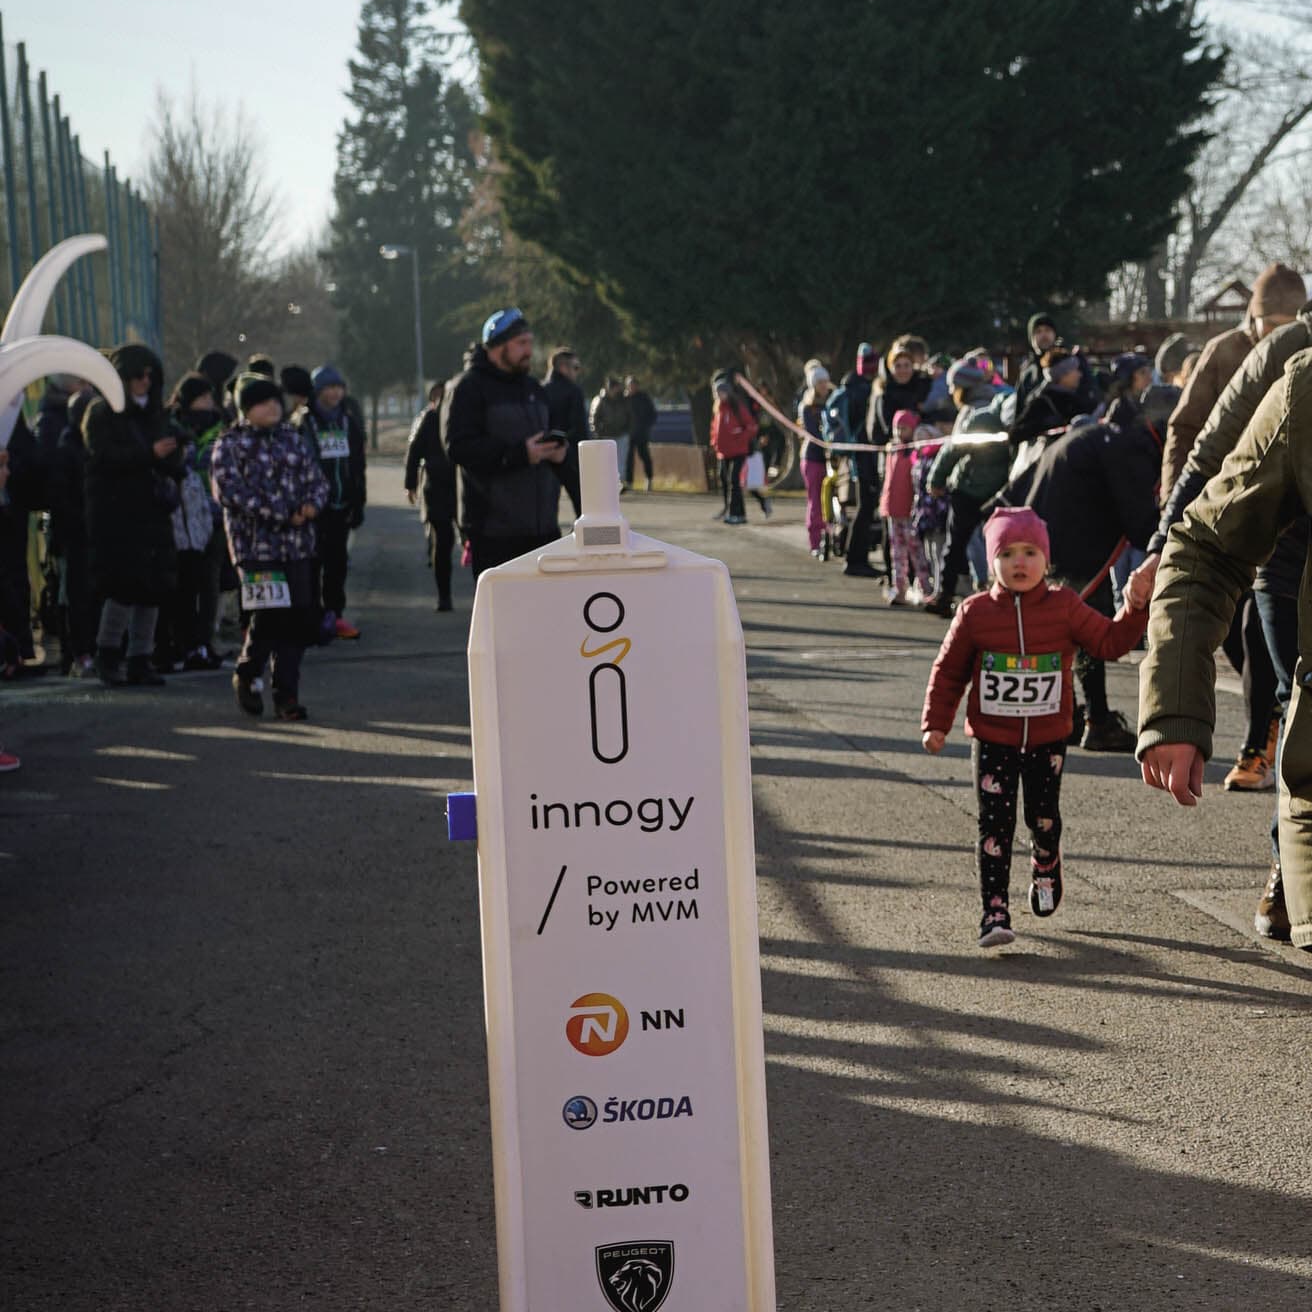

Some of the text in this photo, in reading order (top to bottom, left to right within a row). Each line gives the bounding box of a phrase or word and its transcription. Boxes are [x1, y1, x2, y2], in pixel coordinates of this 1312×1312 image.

[246, 582, 285, 601] 3213
[983, 673, 1057, 704] 3257
[530, 793, 695, 833] innogy
[587, 868, 700, 897] Powered
[588, 899, 699, 932] by MVM
[640, 1008, 686, 1031] NN
[602, 1095, 694, 1123] ŠKODA
[596, 1183, 690, 1208] RUNTO
[603, 1247, 668, 1260] PEUGEOT
